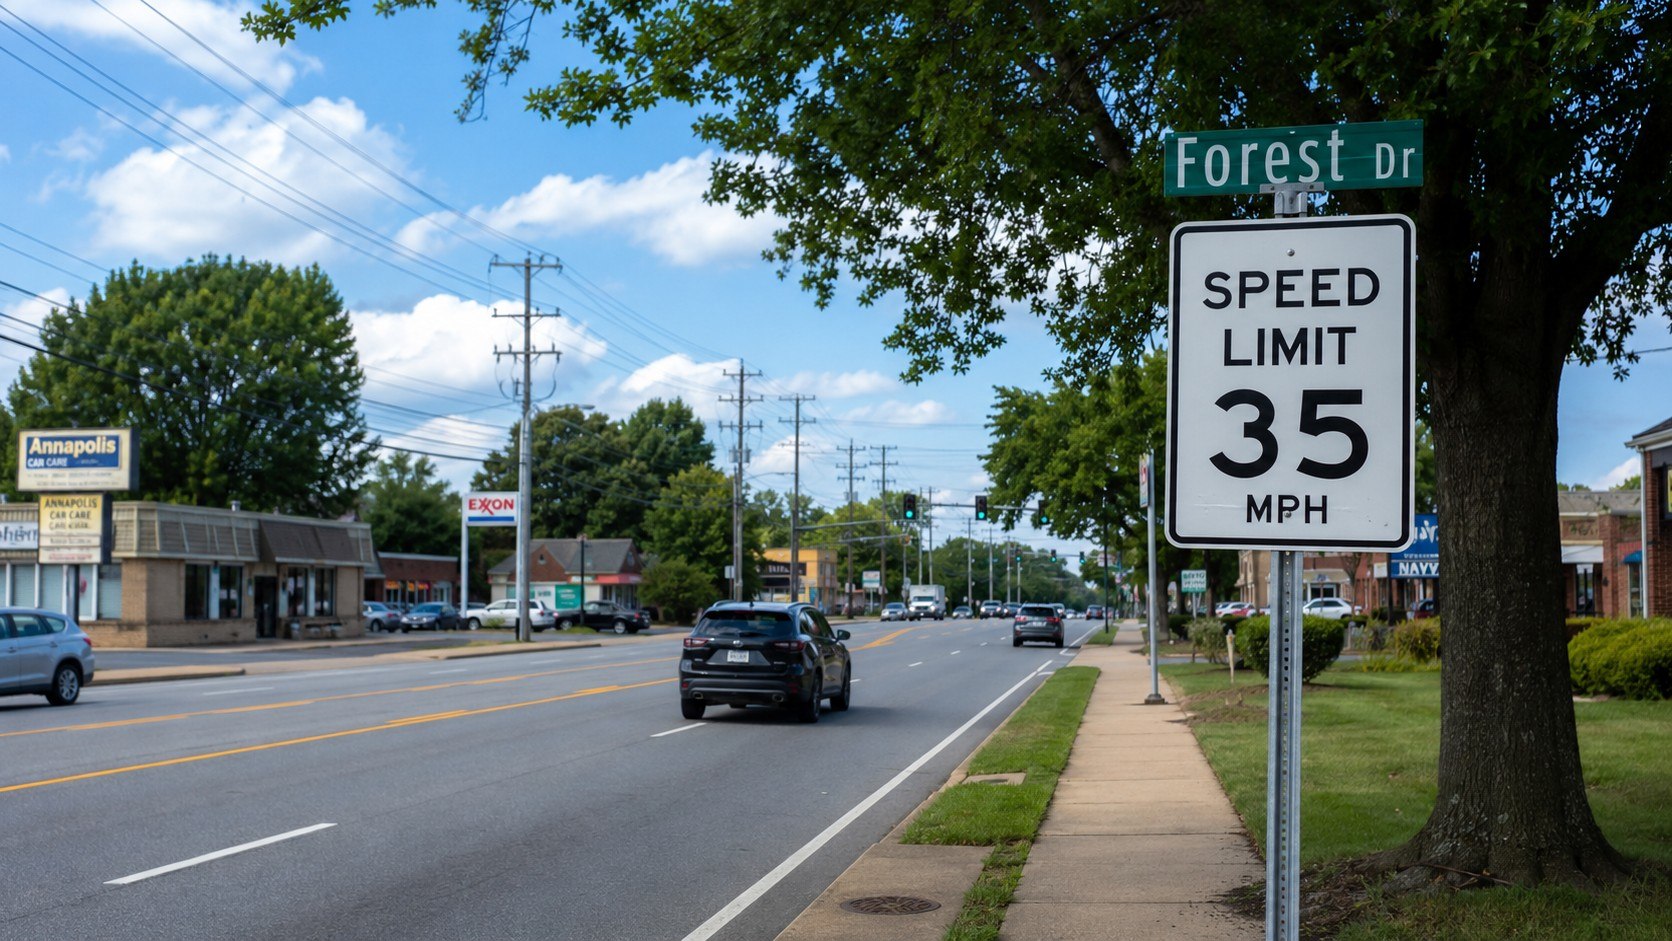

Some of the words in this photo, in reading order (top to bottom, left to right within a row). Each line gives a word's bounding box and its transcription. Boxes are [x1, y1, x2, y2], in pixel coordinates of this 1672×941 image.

[1177, 129, 1344, 188] Forest
[1375, 142, 1415, 180] Dr
[1202, 267, 1380, 310] SPEED
[1224, 326, 1357, 366] LIMIT
[29, 436, 116, 458] Annapolis
[1209, 388, 1369, 480] 35
[27, 458, 45, 468] CAR
[44, 498, 97, 509] ANNAPOLIS
[49, 510, 66, 520] CAR
[468, 497, 514, 516] EXXON
[1246, 494, 1328, 524] MPH
